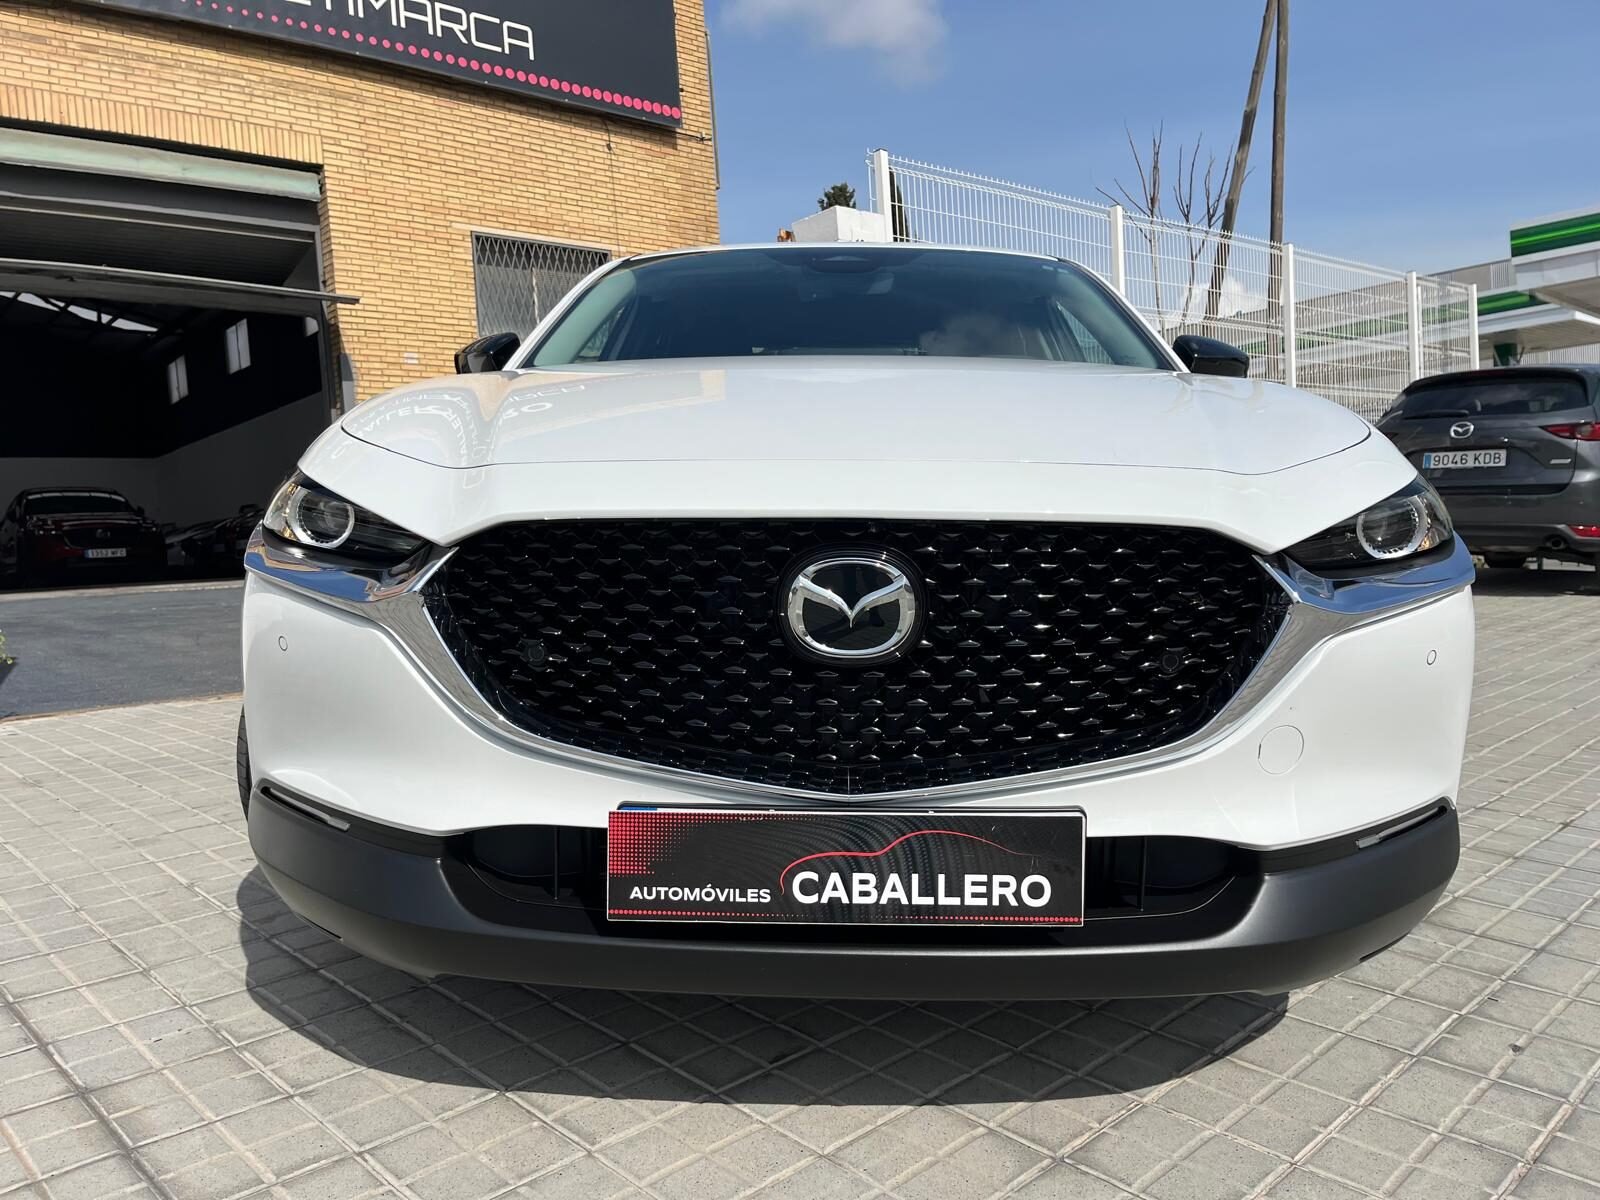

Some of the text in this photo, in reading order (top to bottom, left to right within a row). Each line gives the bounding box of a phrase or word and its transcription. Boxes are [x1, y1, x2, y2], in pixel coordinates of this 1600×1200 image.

[284, 0, 534, 61] MARCA
[1432, 452, 1502, 466] 9046 KDB
[629, 871, 1052, 907] AUTOMÓVILES CABALLERO
